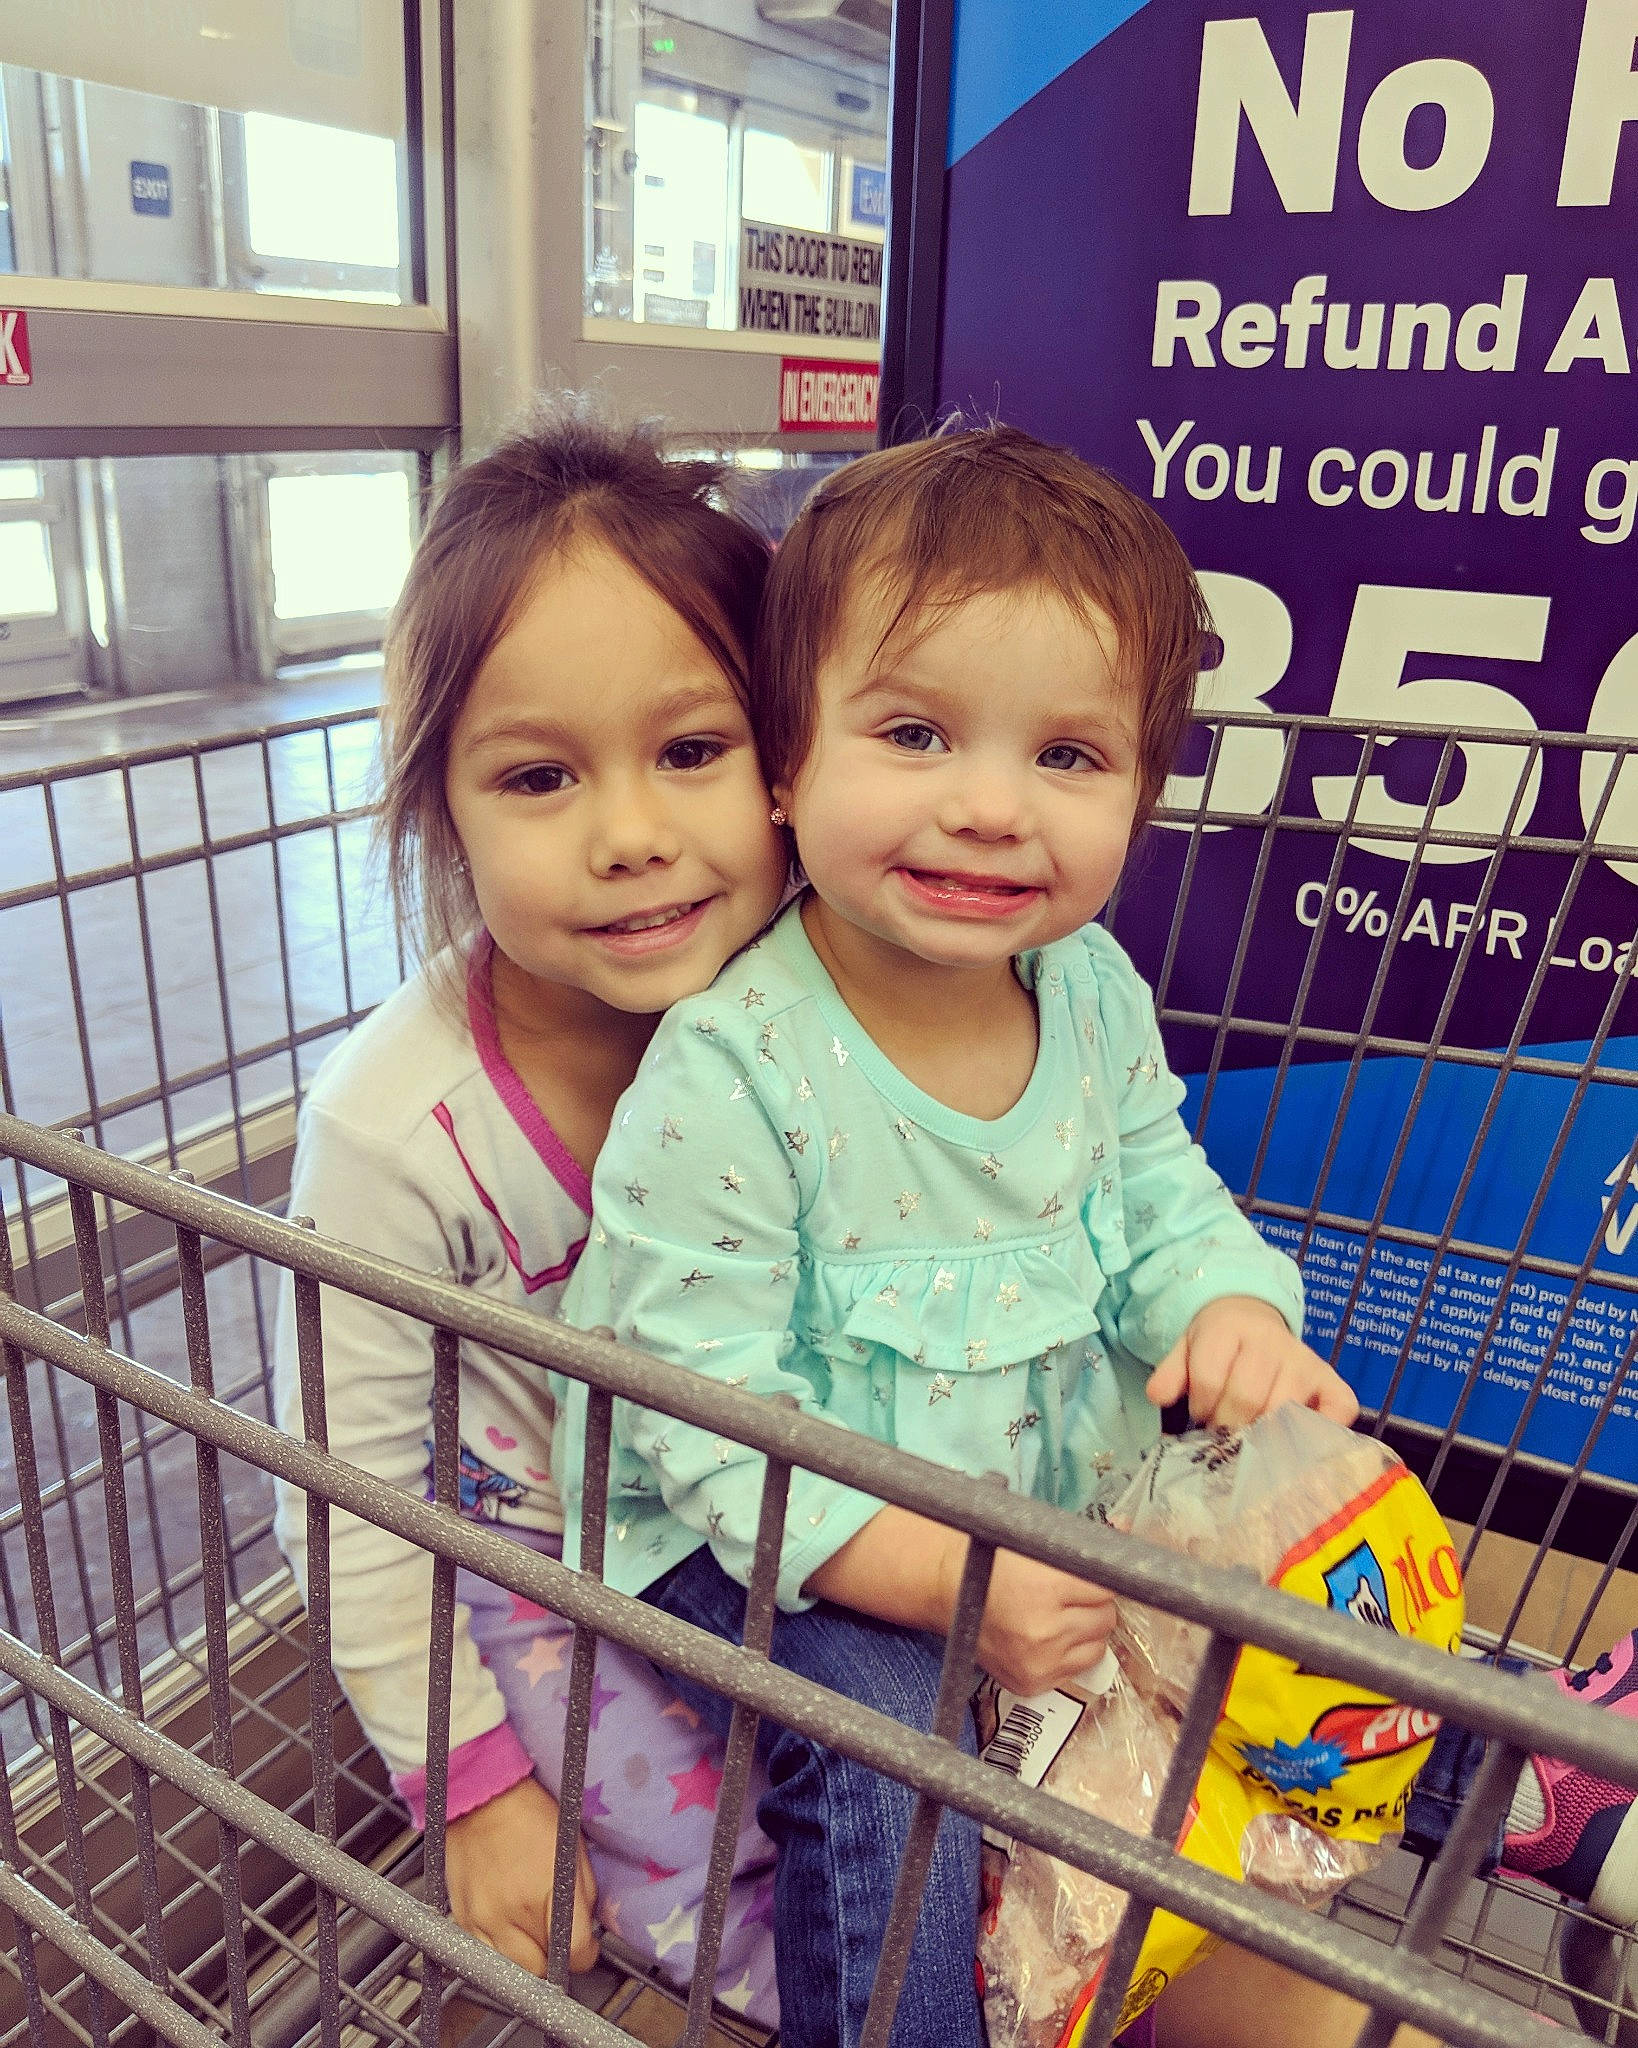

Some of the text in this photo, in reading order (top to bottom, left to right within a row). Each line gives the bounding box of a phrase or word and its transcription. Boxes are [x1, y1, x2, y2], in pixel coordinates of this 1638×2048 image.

[1188, 9, 1496, 217] No
[745, 227, 782, 273] THIS
[785, 234, 828, 279] DOOR
[830, 242, 849, 282] TO
[740, 287, 792, 332] WHEN
[794, 293, 821, 336] THE
[1151, 274, 1638, 374] Refund A
[782, 371, 800, 423] IN
[1136, 418, 1283, 505] You
[1308, 425, 1560, 518] could
[1295, 881, 1390, 938] 0%
[1401, 898, 1529, 960] APR
[1284, 1245, 1338, 1269] reunds
[1340, 1259, 1363, 1275] an
[1370, 1265, 1419, 1289] reduce
[1450, 1286, 1507, 1311] amoun
[1510, 1301, 1544, 1320] paid
[1546, 1308, 1605, 1337] diectly
[1608, 1323, 1626, 1340] to
[1315, 1233, 1345, 1252] loan
[1347, 1240, 1378, 1261] (nt
[1380, 1247, 1404, 1267] the
[1405, 1256, 1452, 1278] actal
[1454, 1267, 1478, 1285] tax
[1480, 1275, 1537, 1301] refnd)
[1538, 1289, 1606, 1316] provded
[1608, 1302, 1627, 1323] by
[1310, 1286, 1350, 1308] other
[1351, 1300, 1428, 1328] cceptabe
[1430, 1317, 1483, 1342] income
[1582, 1356, 1613, 1375] and
[1317, 1325, 1362, 1347] unlss
[1364, 1336, 1431, 1365] impated
[1433, 1354, 1451, 1373] by
[1453, 1358, 1480, 1378] IR
[1348, 1314, 1405, 1341] ligibility
[1413, 1332, 1463, 1357] riteria,
[1466, 1346, 1495, 1364] ad
[1379, 1286, 1435, 1311] withot
[1509, 1316, 1531, 1334] for
[1537, 1324, 1567, 1344] ths
[1571, 1332, 1608, 1355] loan.
